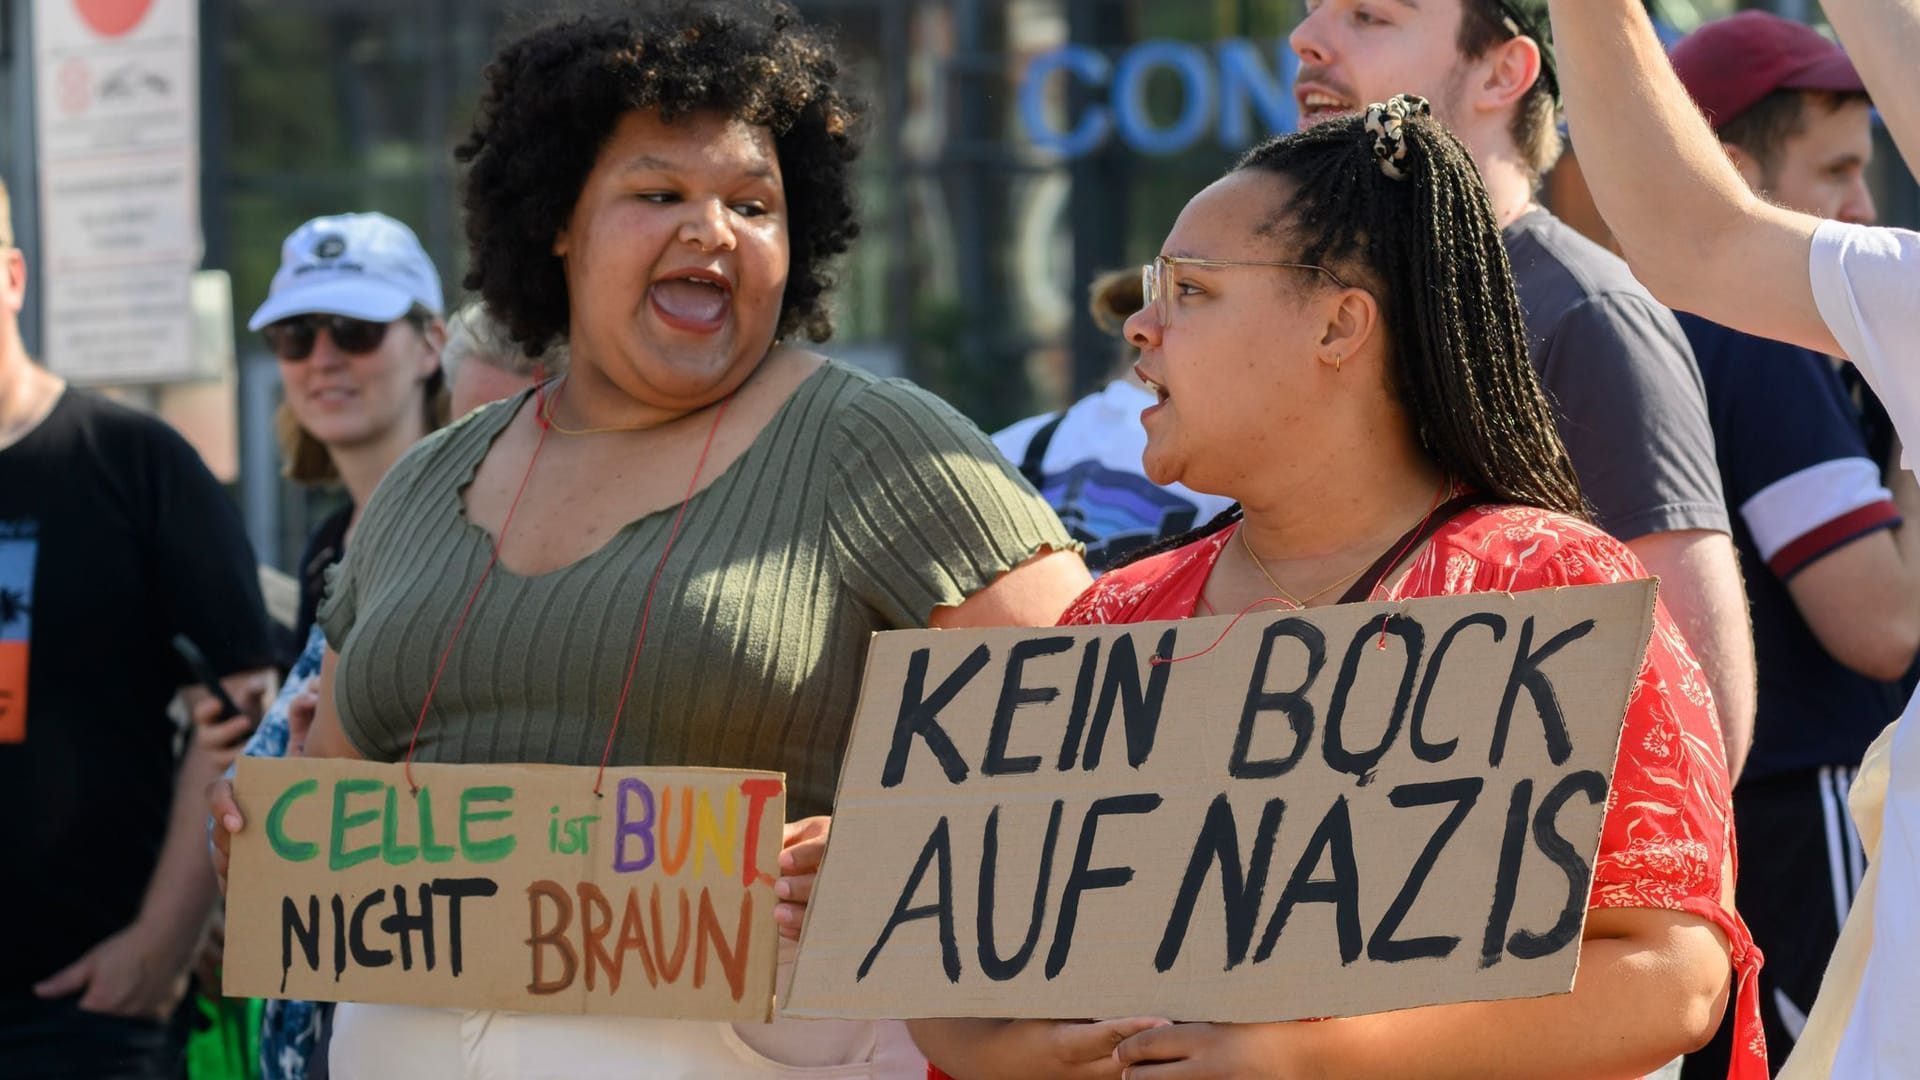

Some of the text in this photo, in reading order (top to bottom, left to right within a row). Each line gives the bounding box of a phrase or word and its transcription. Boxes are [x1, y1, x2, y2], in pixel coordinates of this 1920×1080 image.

[1018, 39, 1299, 156] CON
[882, 612, 1597, 787] KEIN BOCK
[265, 779, 516, 871] CELLE
[612, 778, 783, 888] BUNT
[857, 770, 1607, 982] AUF NAZIS
[281, 878, 753, 1000] NICHT BRAUN
